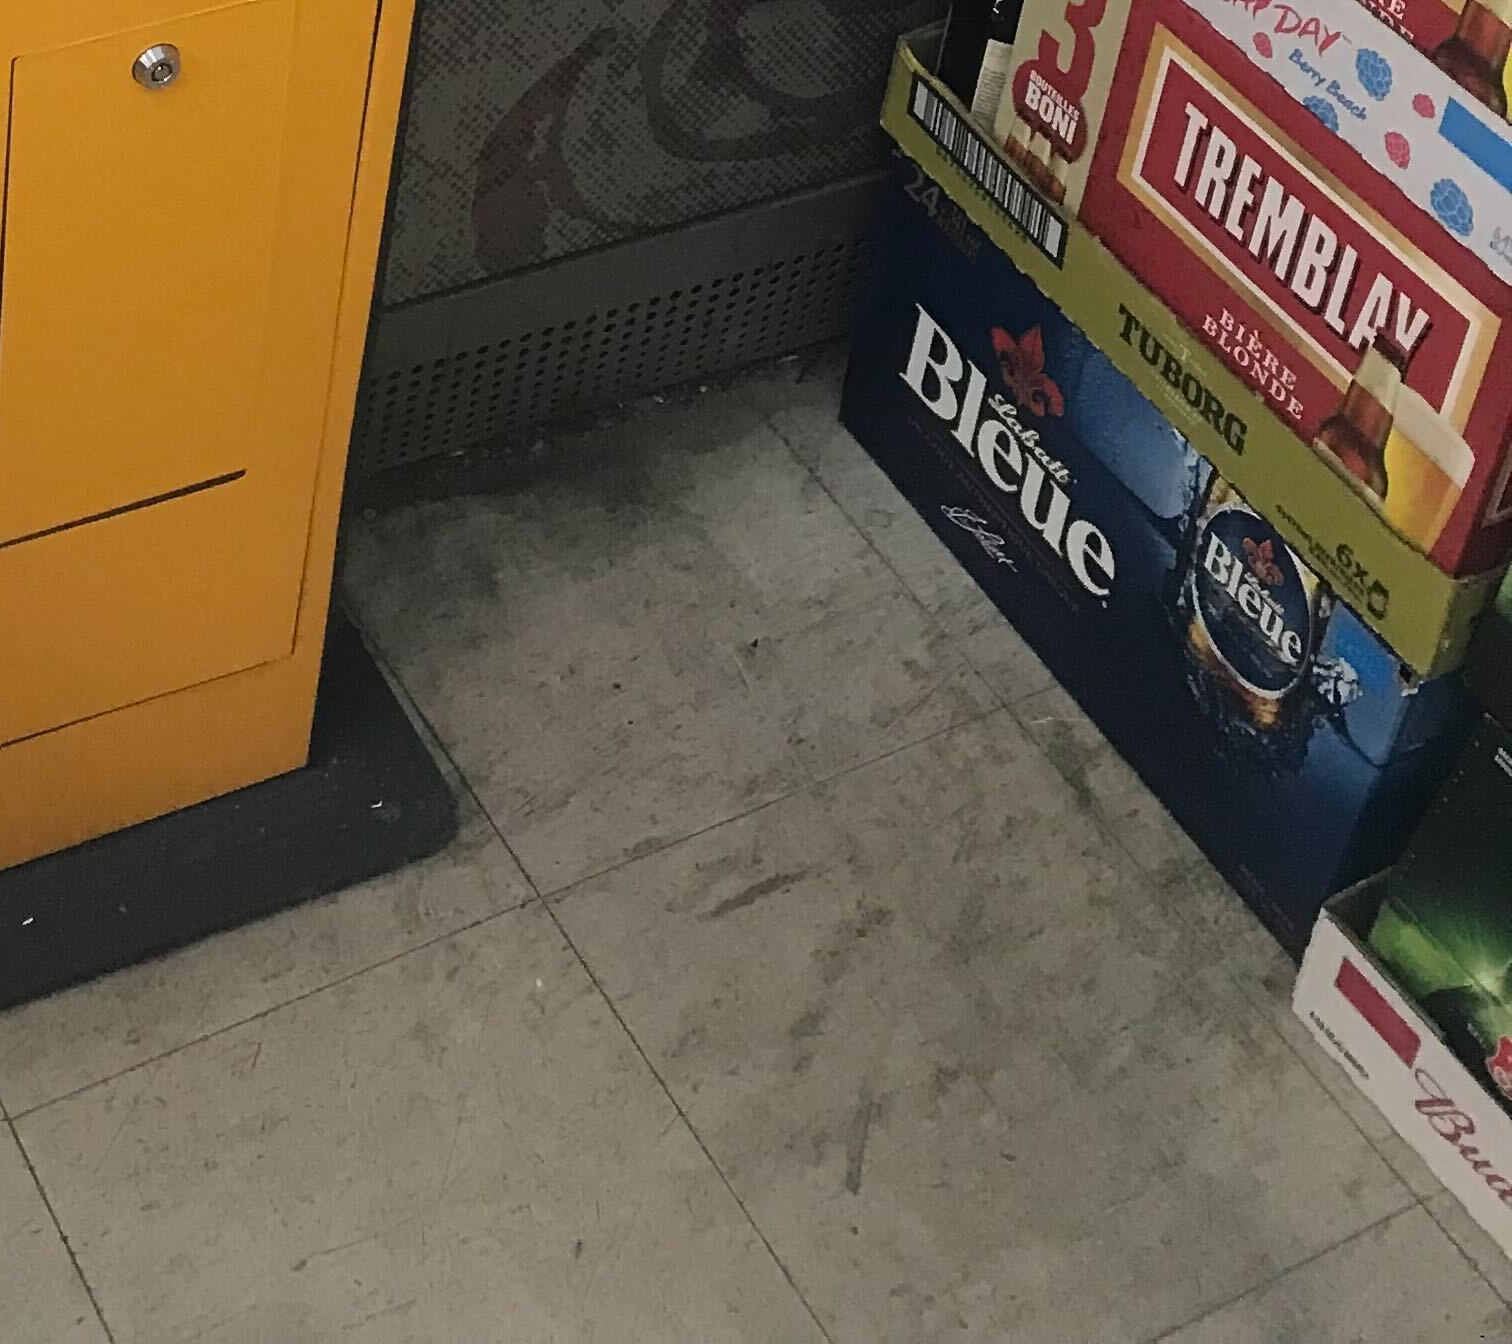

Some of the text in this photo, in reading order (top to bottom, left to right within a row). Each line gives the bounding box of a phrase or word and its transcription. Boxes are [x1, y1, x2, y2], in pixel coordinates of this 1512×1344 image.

[1274, 4, 1342, 57] DAY
[1024, 79, 1078, 145] BONI
[1030, 69, 1080, 120] BOUTEILLES
[1289, 49, 1367, 121] Berry Beach
[1118, 304, 1248, 456] TUBORG
[1202, 315, 1304, 420] BLONDE
[1219, 308, 1298, 391] BIÈRE
[899, 304, 1116, 596] Bleue
[1204, 532, 1301, 666] Bleue
